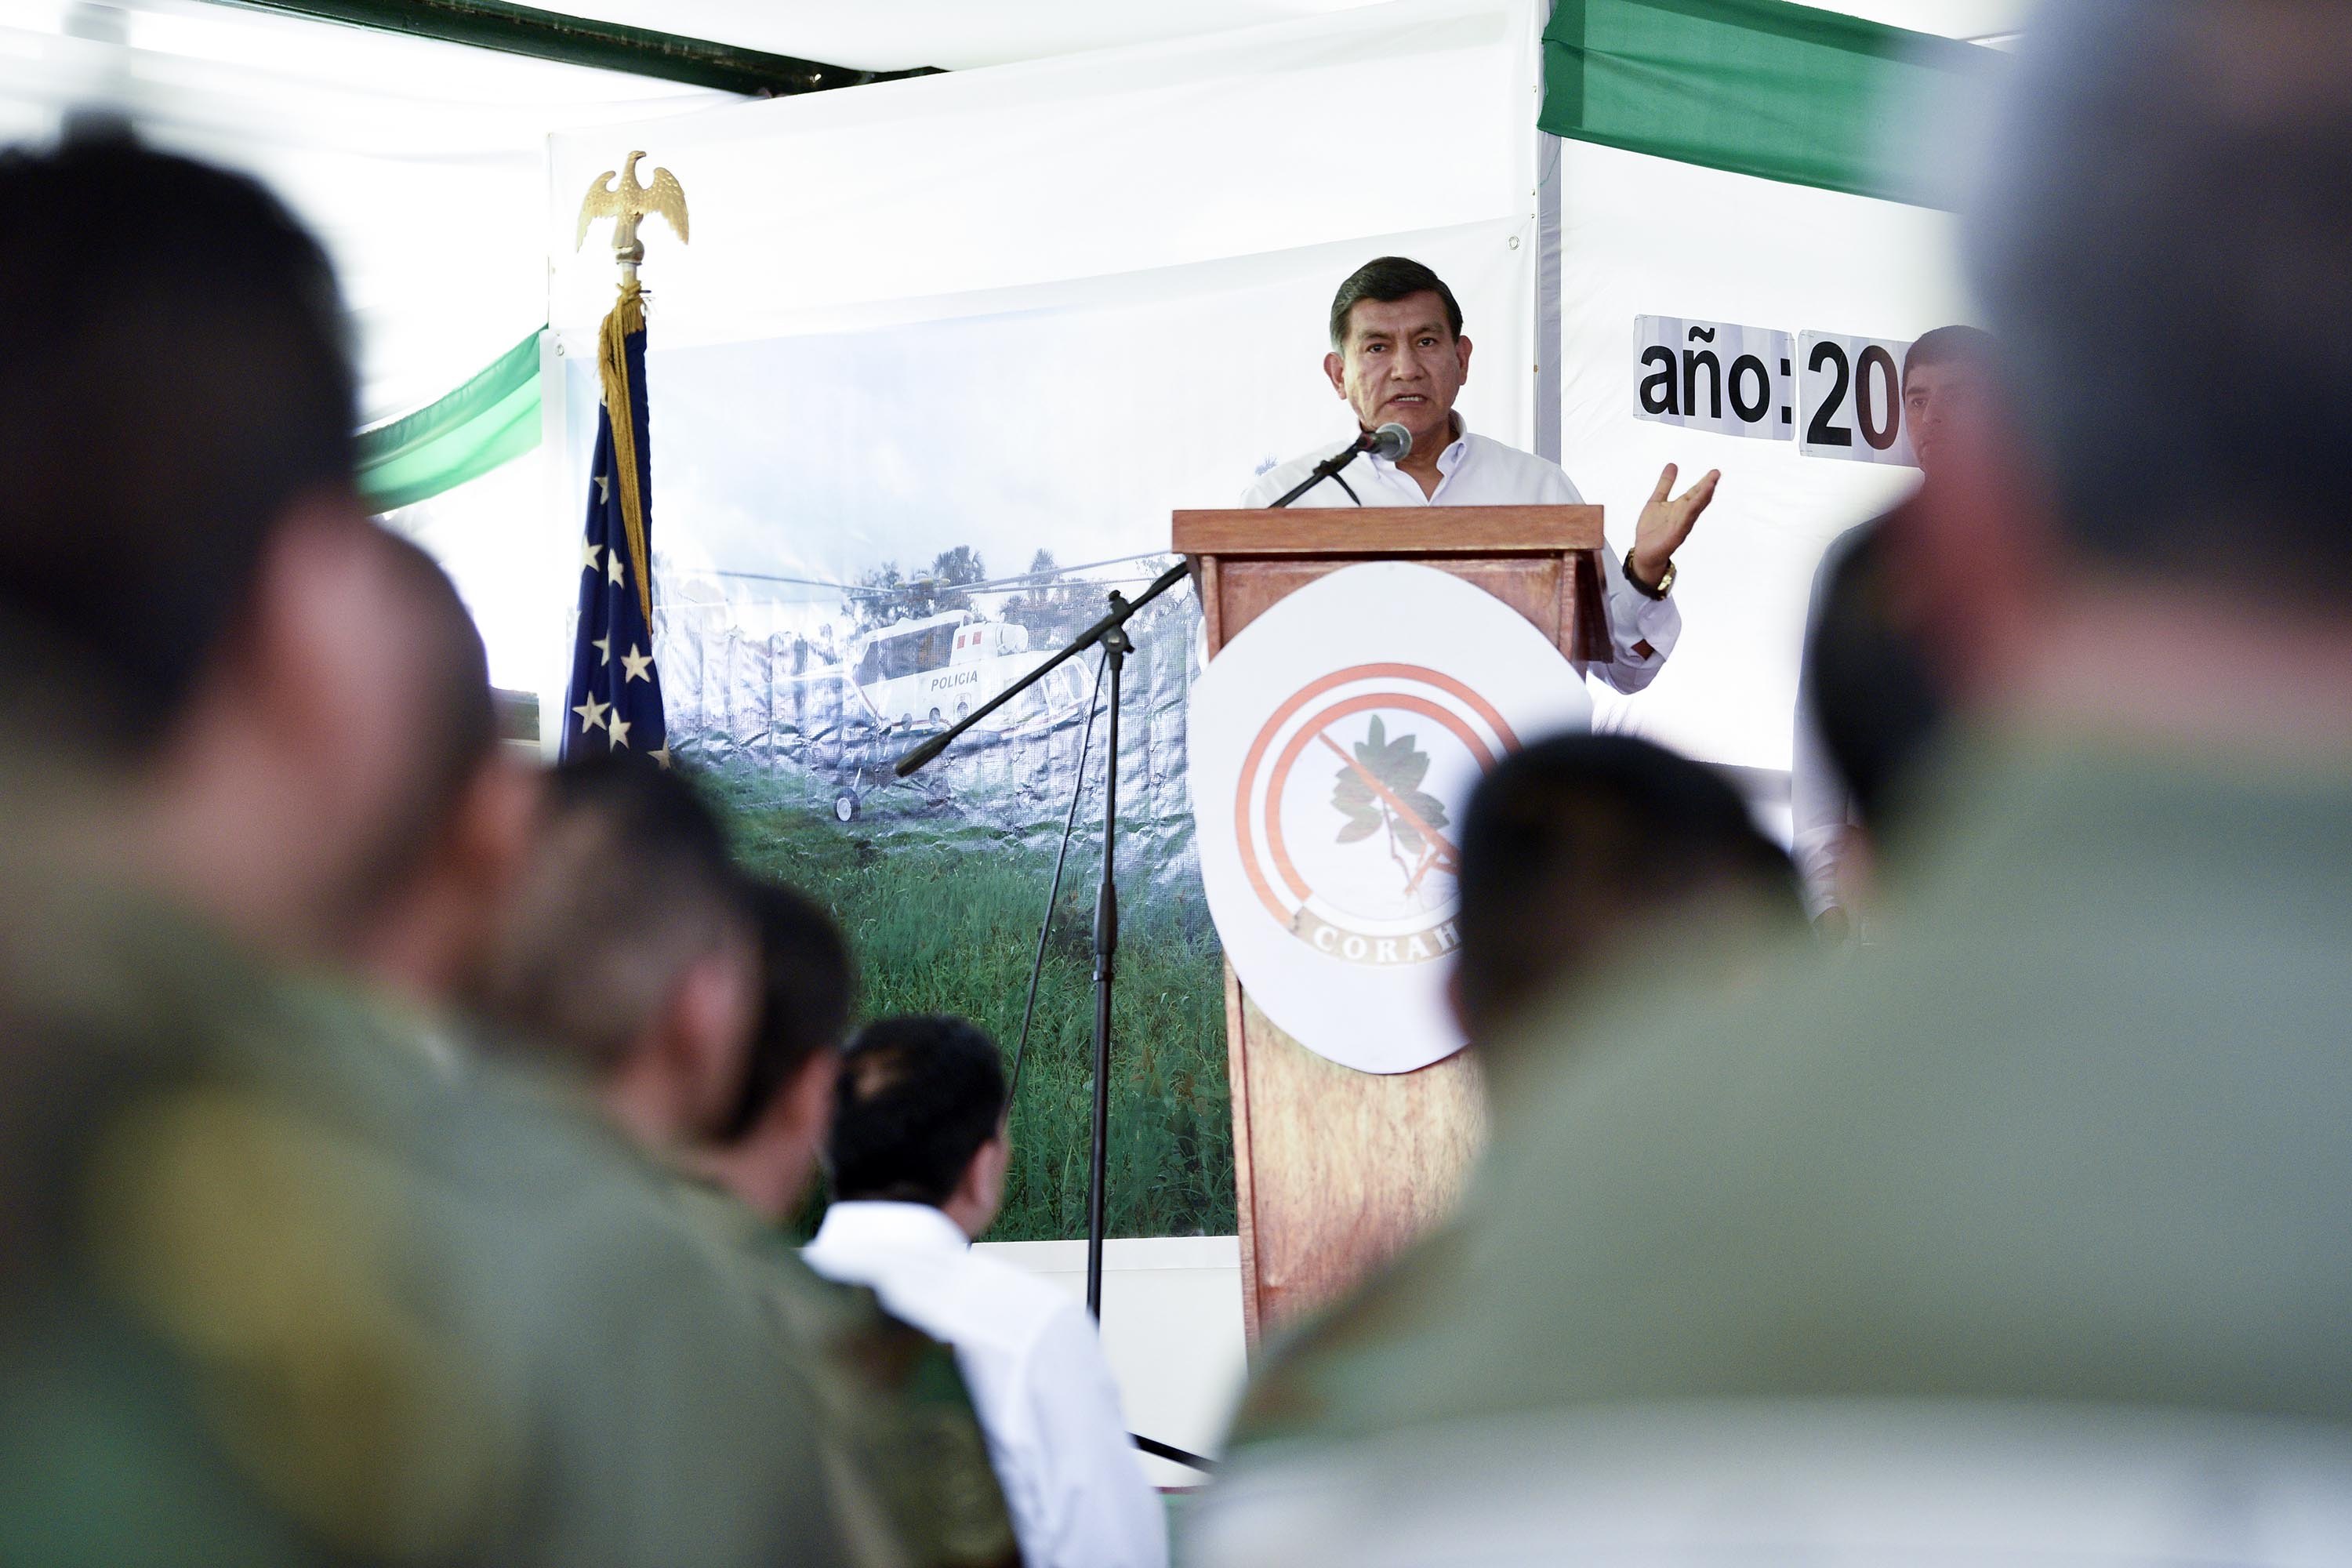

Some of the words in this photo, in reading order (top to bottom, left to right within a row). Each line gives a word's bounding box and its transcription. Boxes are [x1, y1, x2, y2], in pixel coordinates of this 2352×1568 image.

[1640, 325, 1791, 424] año:
[931, 670, 978, 691] POLICIA
[1314, 923, 1462, 962] CORAH
